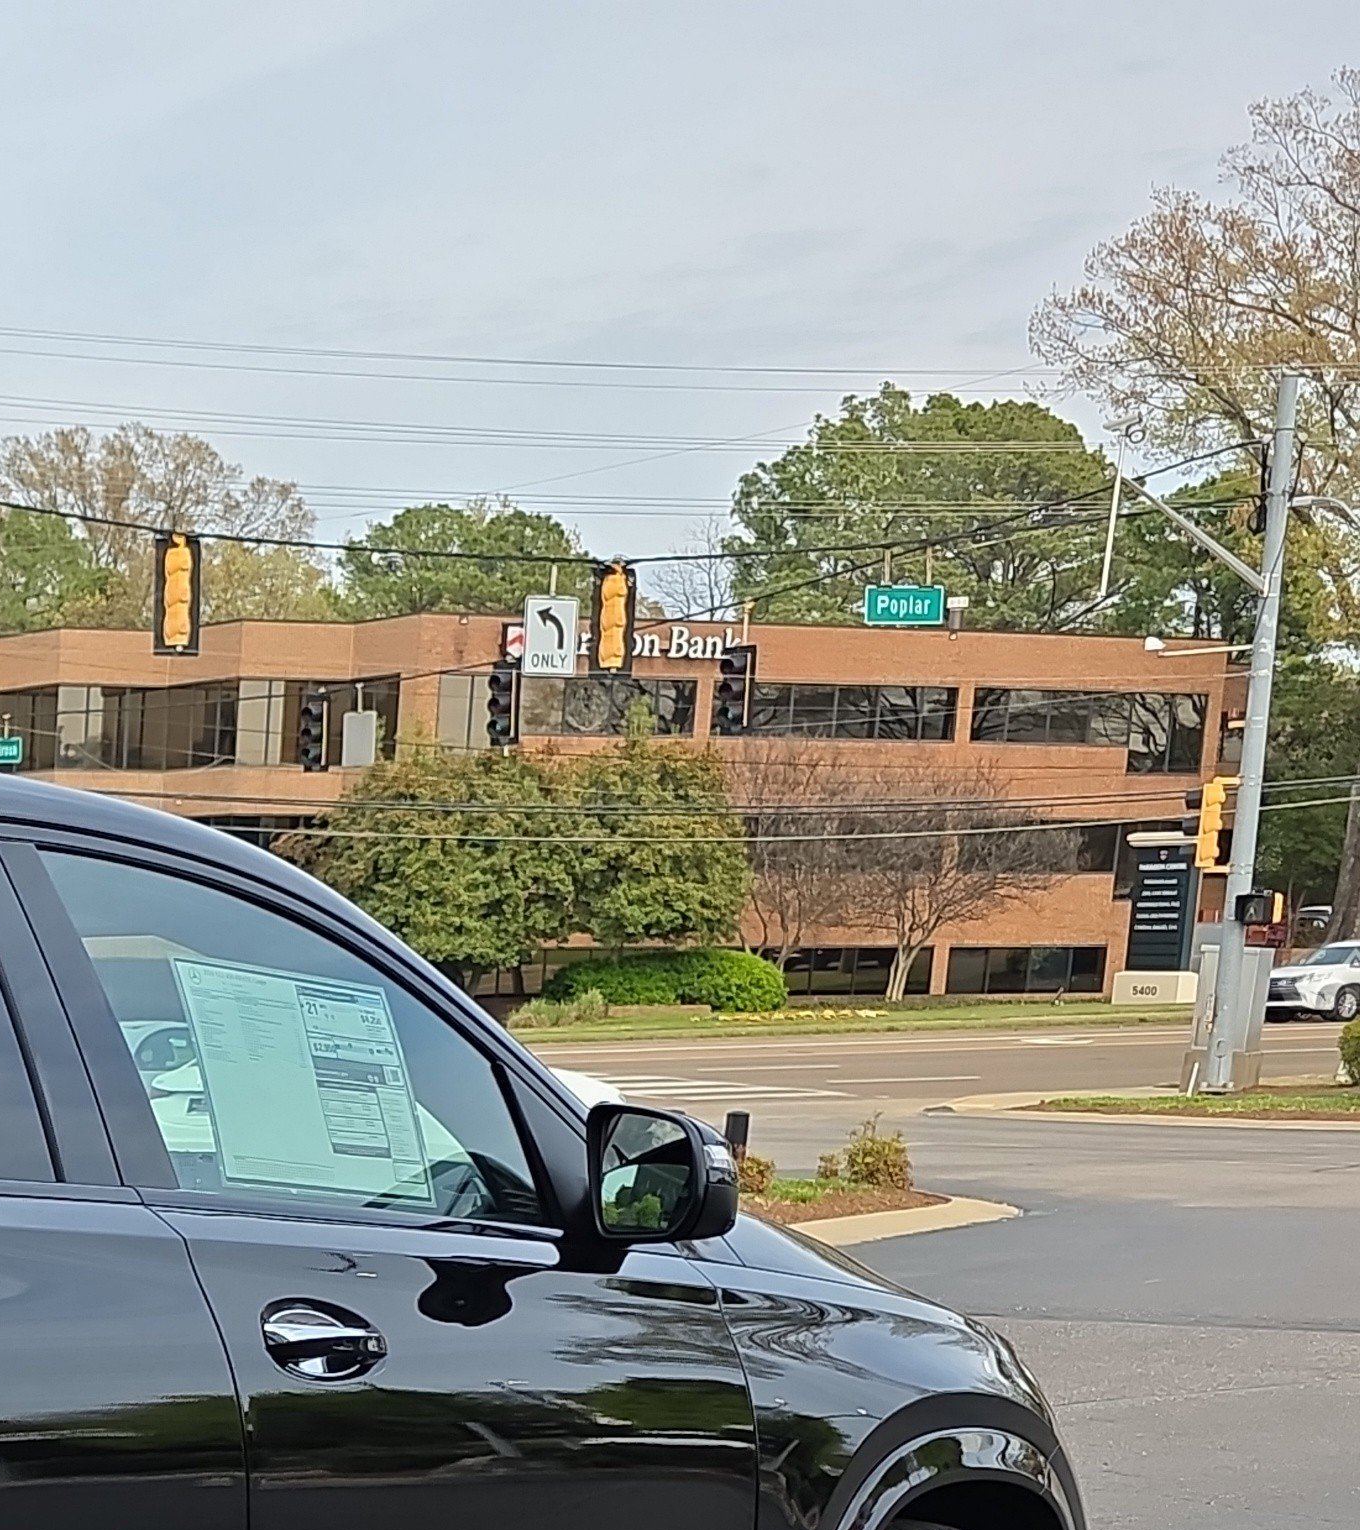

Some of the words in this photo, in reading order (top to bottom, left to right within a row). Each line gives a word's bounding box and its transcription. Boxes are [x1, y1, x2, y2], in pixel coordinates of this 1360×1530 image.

[877, 595, 931, 618] Poplar
[667, 626, 742, 660] Bank
[531, 653, 568, 669] ONLY
[1132, 985, 1157, 996] 5400
